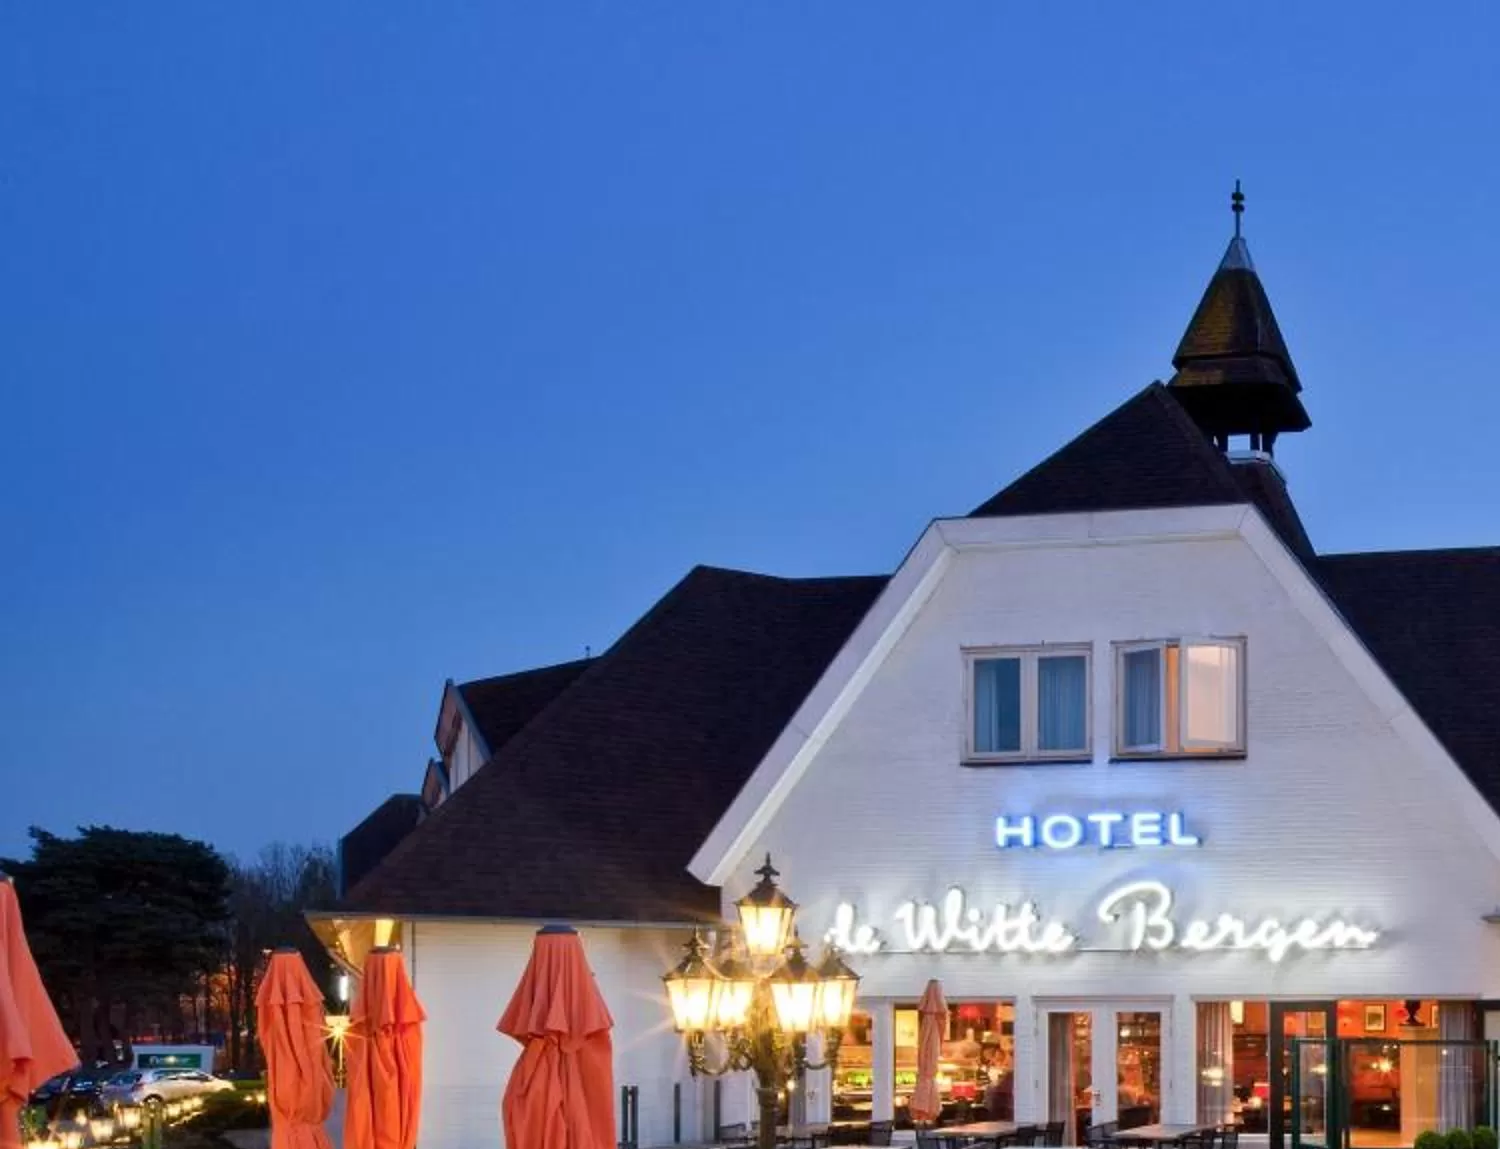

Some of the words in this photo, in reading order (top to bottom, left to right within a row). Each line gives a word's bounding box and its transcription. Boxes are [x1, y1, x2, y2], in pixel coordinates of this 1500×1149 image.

[996, 813, 1199, 849] HOTEL
[824, 902, 882, 953] de
[895, 886, 1075, 952] Witte
[1097, 881, 1379, 963] Bergen
